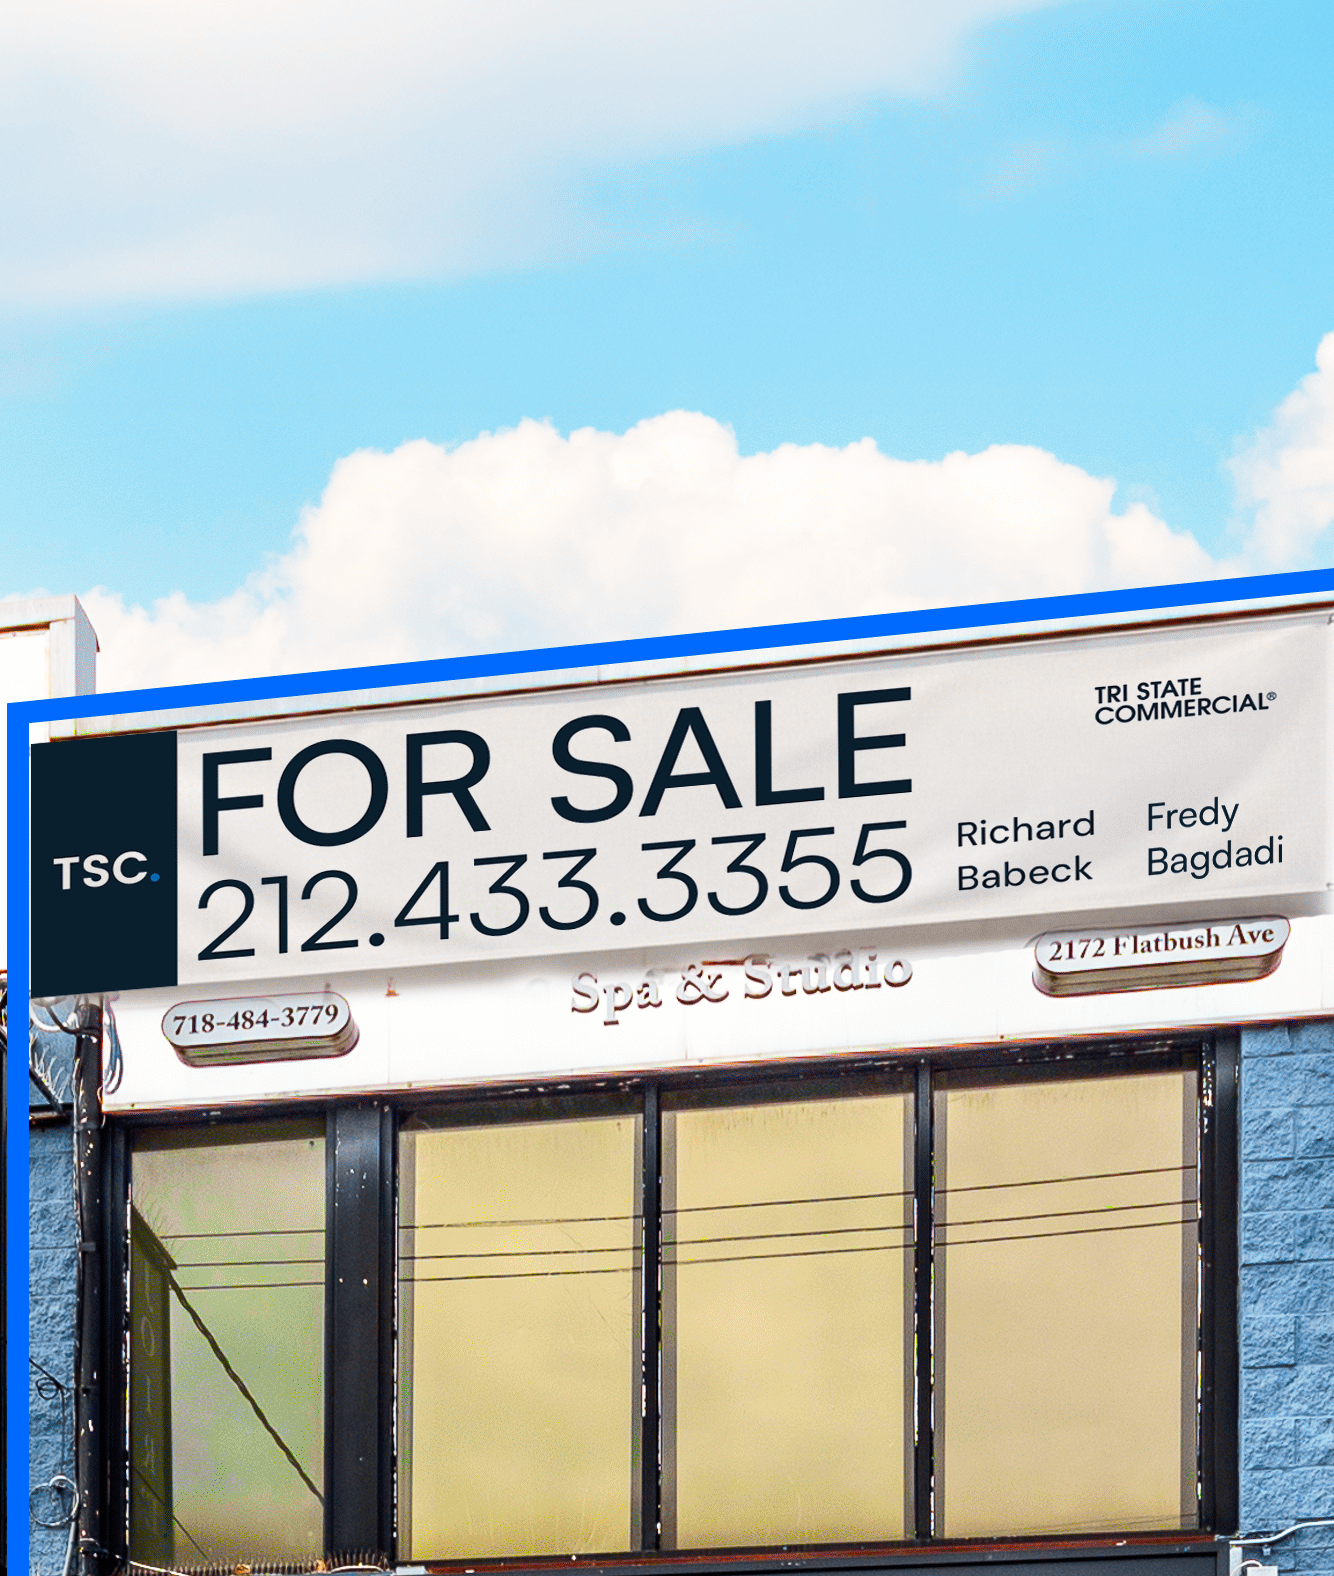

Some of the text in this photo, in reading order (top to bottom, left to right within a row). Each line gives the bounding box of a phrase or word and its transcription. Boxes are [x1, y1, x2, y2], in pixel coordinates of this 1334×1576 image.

[1094, 677, 1202, 704] TRI STATE
[201, 686, 912, 857] FOR SALE
[956, 809, 1096, 847] Richard
[1147, 796, 1240, 832] Fredy
[957, 855, 1094, 891] Babeck
[1147, 835, 1284, 880] Bagdadi
[197, 819, 913, 961] 212.433.3355
[1048, 923, 1275, 962] 2172 Flatbush Ave
[570, 948, 914, 1026] Spa & Studio
[172, 1003, 339, 1036] 718-484-3779
